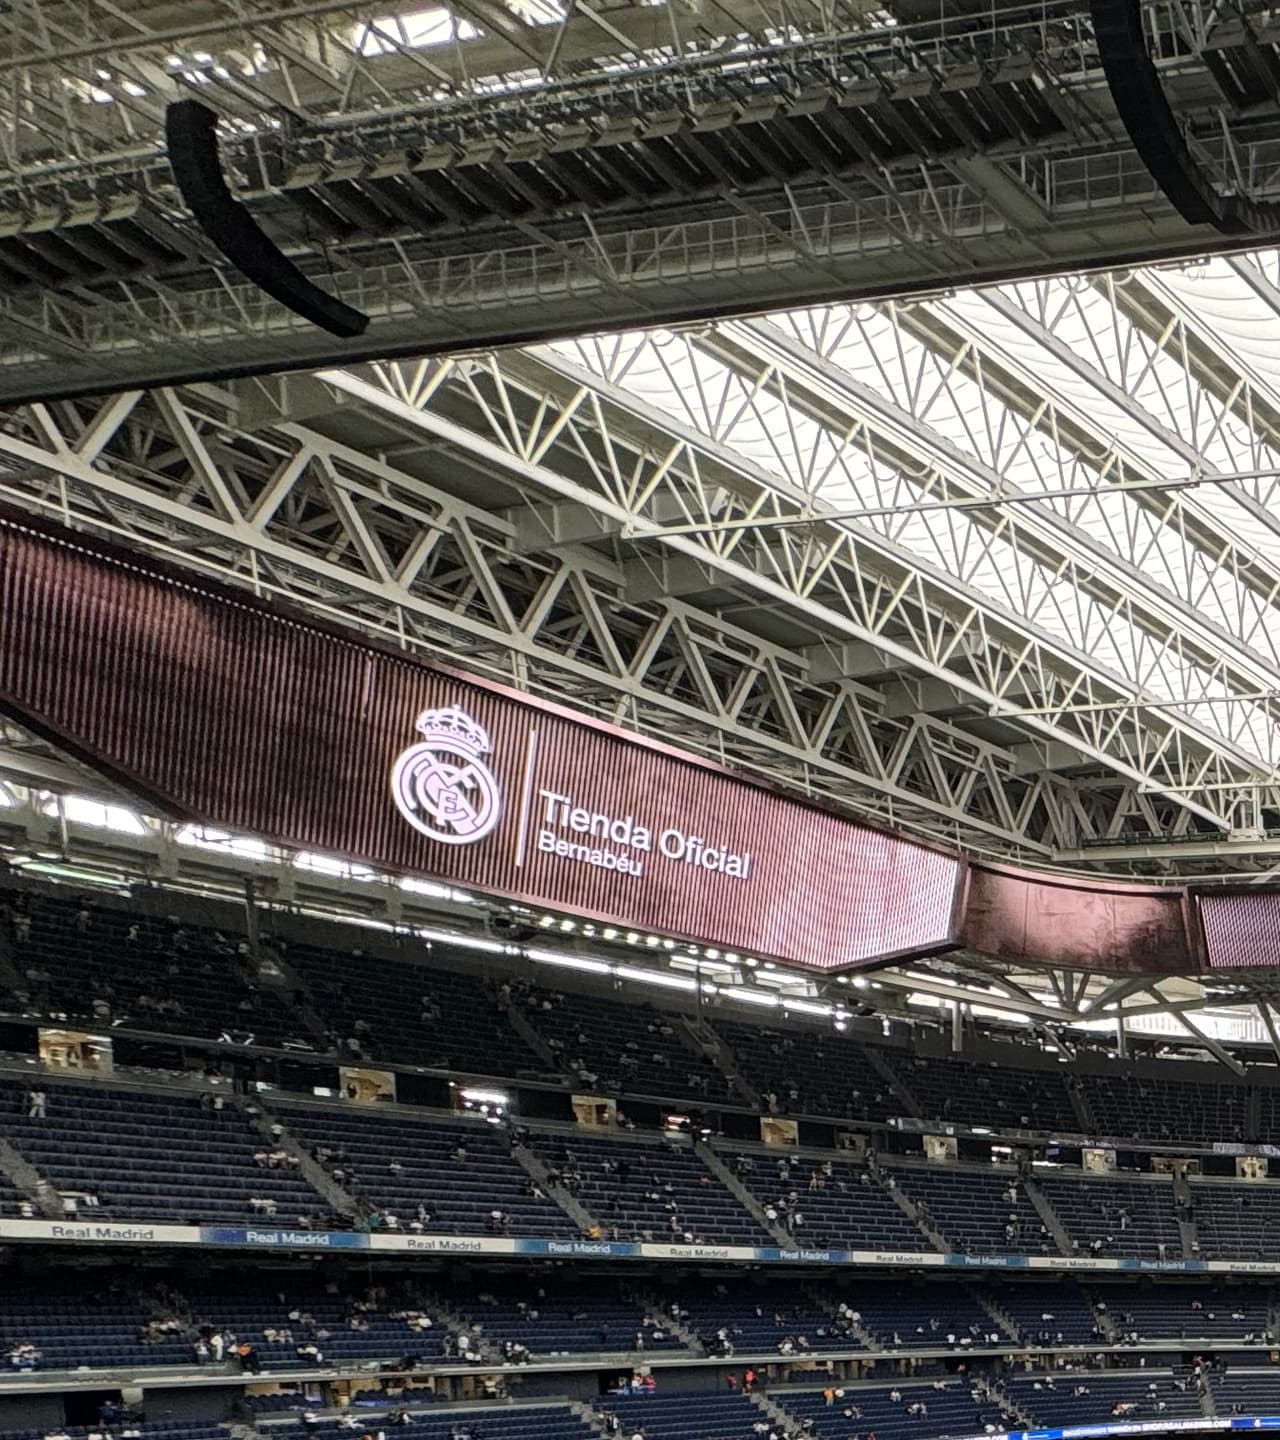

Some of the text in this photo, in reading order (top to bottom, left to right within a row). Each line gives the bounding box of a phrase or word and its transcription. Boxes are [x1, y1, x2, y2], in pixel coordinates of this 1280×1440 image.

[539, 789, 750, 880] Tienda Oficial
[538, 830, 643, 878] Bernabéu
[52, 1226, 154, 1240] Real Madrid
[246, 1231, 330, 1244] Real Madrid
[407, 1239, 481, 1250] Real Madrid
[548, 1242, 611, 1253] Real Madrid
[669, 1247, 728, 1258] Real Madrid
[779, 1250, 829, 1260] Real Madrid
